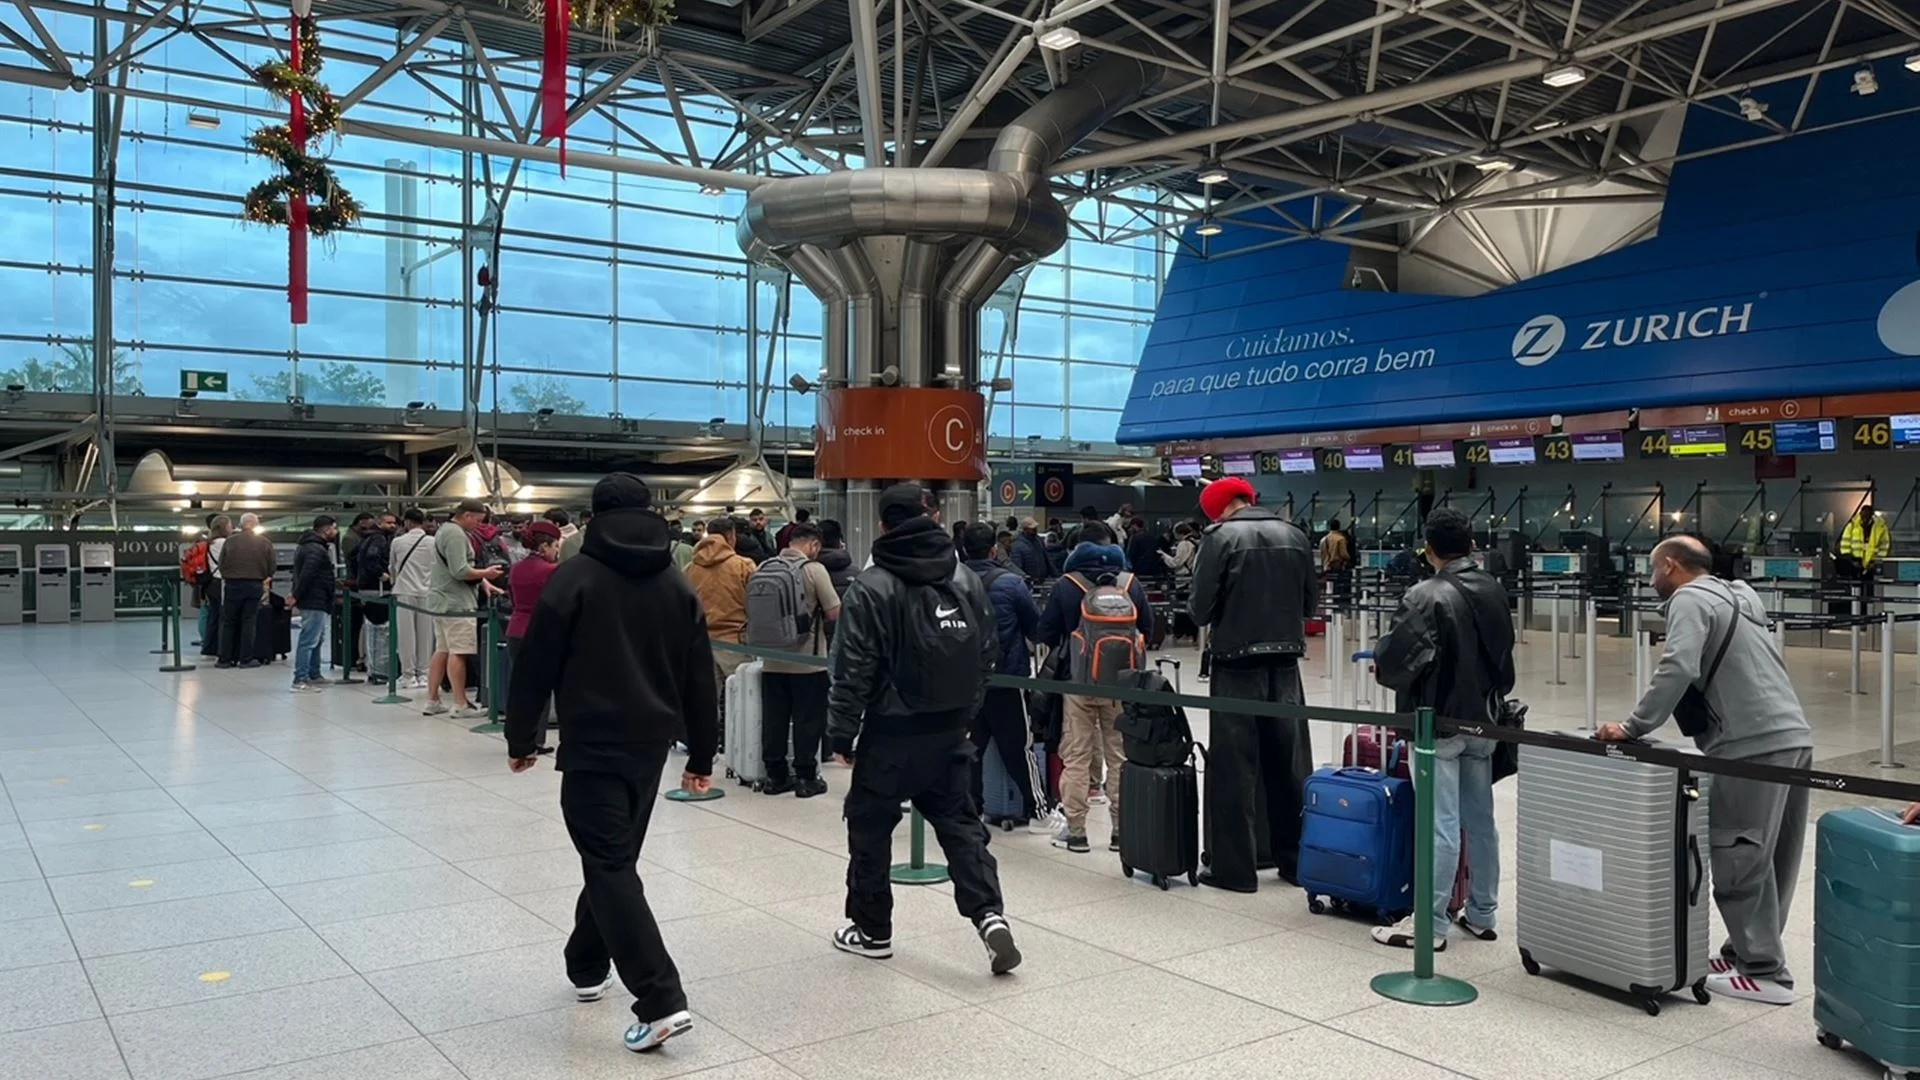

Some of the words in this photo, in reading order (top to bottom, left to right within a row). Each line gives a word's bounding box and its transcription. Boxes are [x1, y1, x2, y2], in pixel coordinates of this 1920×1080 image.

[1580, 302, 1754, 351] ZURICH
[1225, 326, 1355, 359] Cuidamos.
[1149, 376, 1196, 401] para
[1200, 371, 1241, 396] que
[1247, 360, 1299, 387] tudo
[1304, 356, 1369, 380] corra
[1374, 347, 1436, 373] bem
[1728, 407, 1758, 418] check
[1760, 405, 1770, 415] in
[843, 425, 873, 437] check
[875, 424, 885, 436] in
[1741, 428, 1773, 450] 45
[1854, 422, 1889, 445] 46
[1544, 440, 1570, 460] 43
[1640, 434, 1669, 454] 44
[1323, 452, 1343, 469] 40
[1393, 448, 1413, 466] 41
[1465, 445, 1489, 463] 42
[1262, 456, 1279, 472] 39
[118, 541, 151, 553] JOY
[940, 620, 967, 629] AIR
